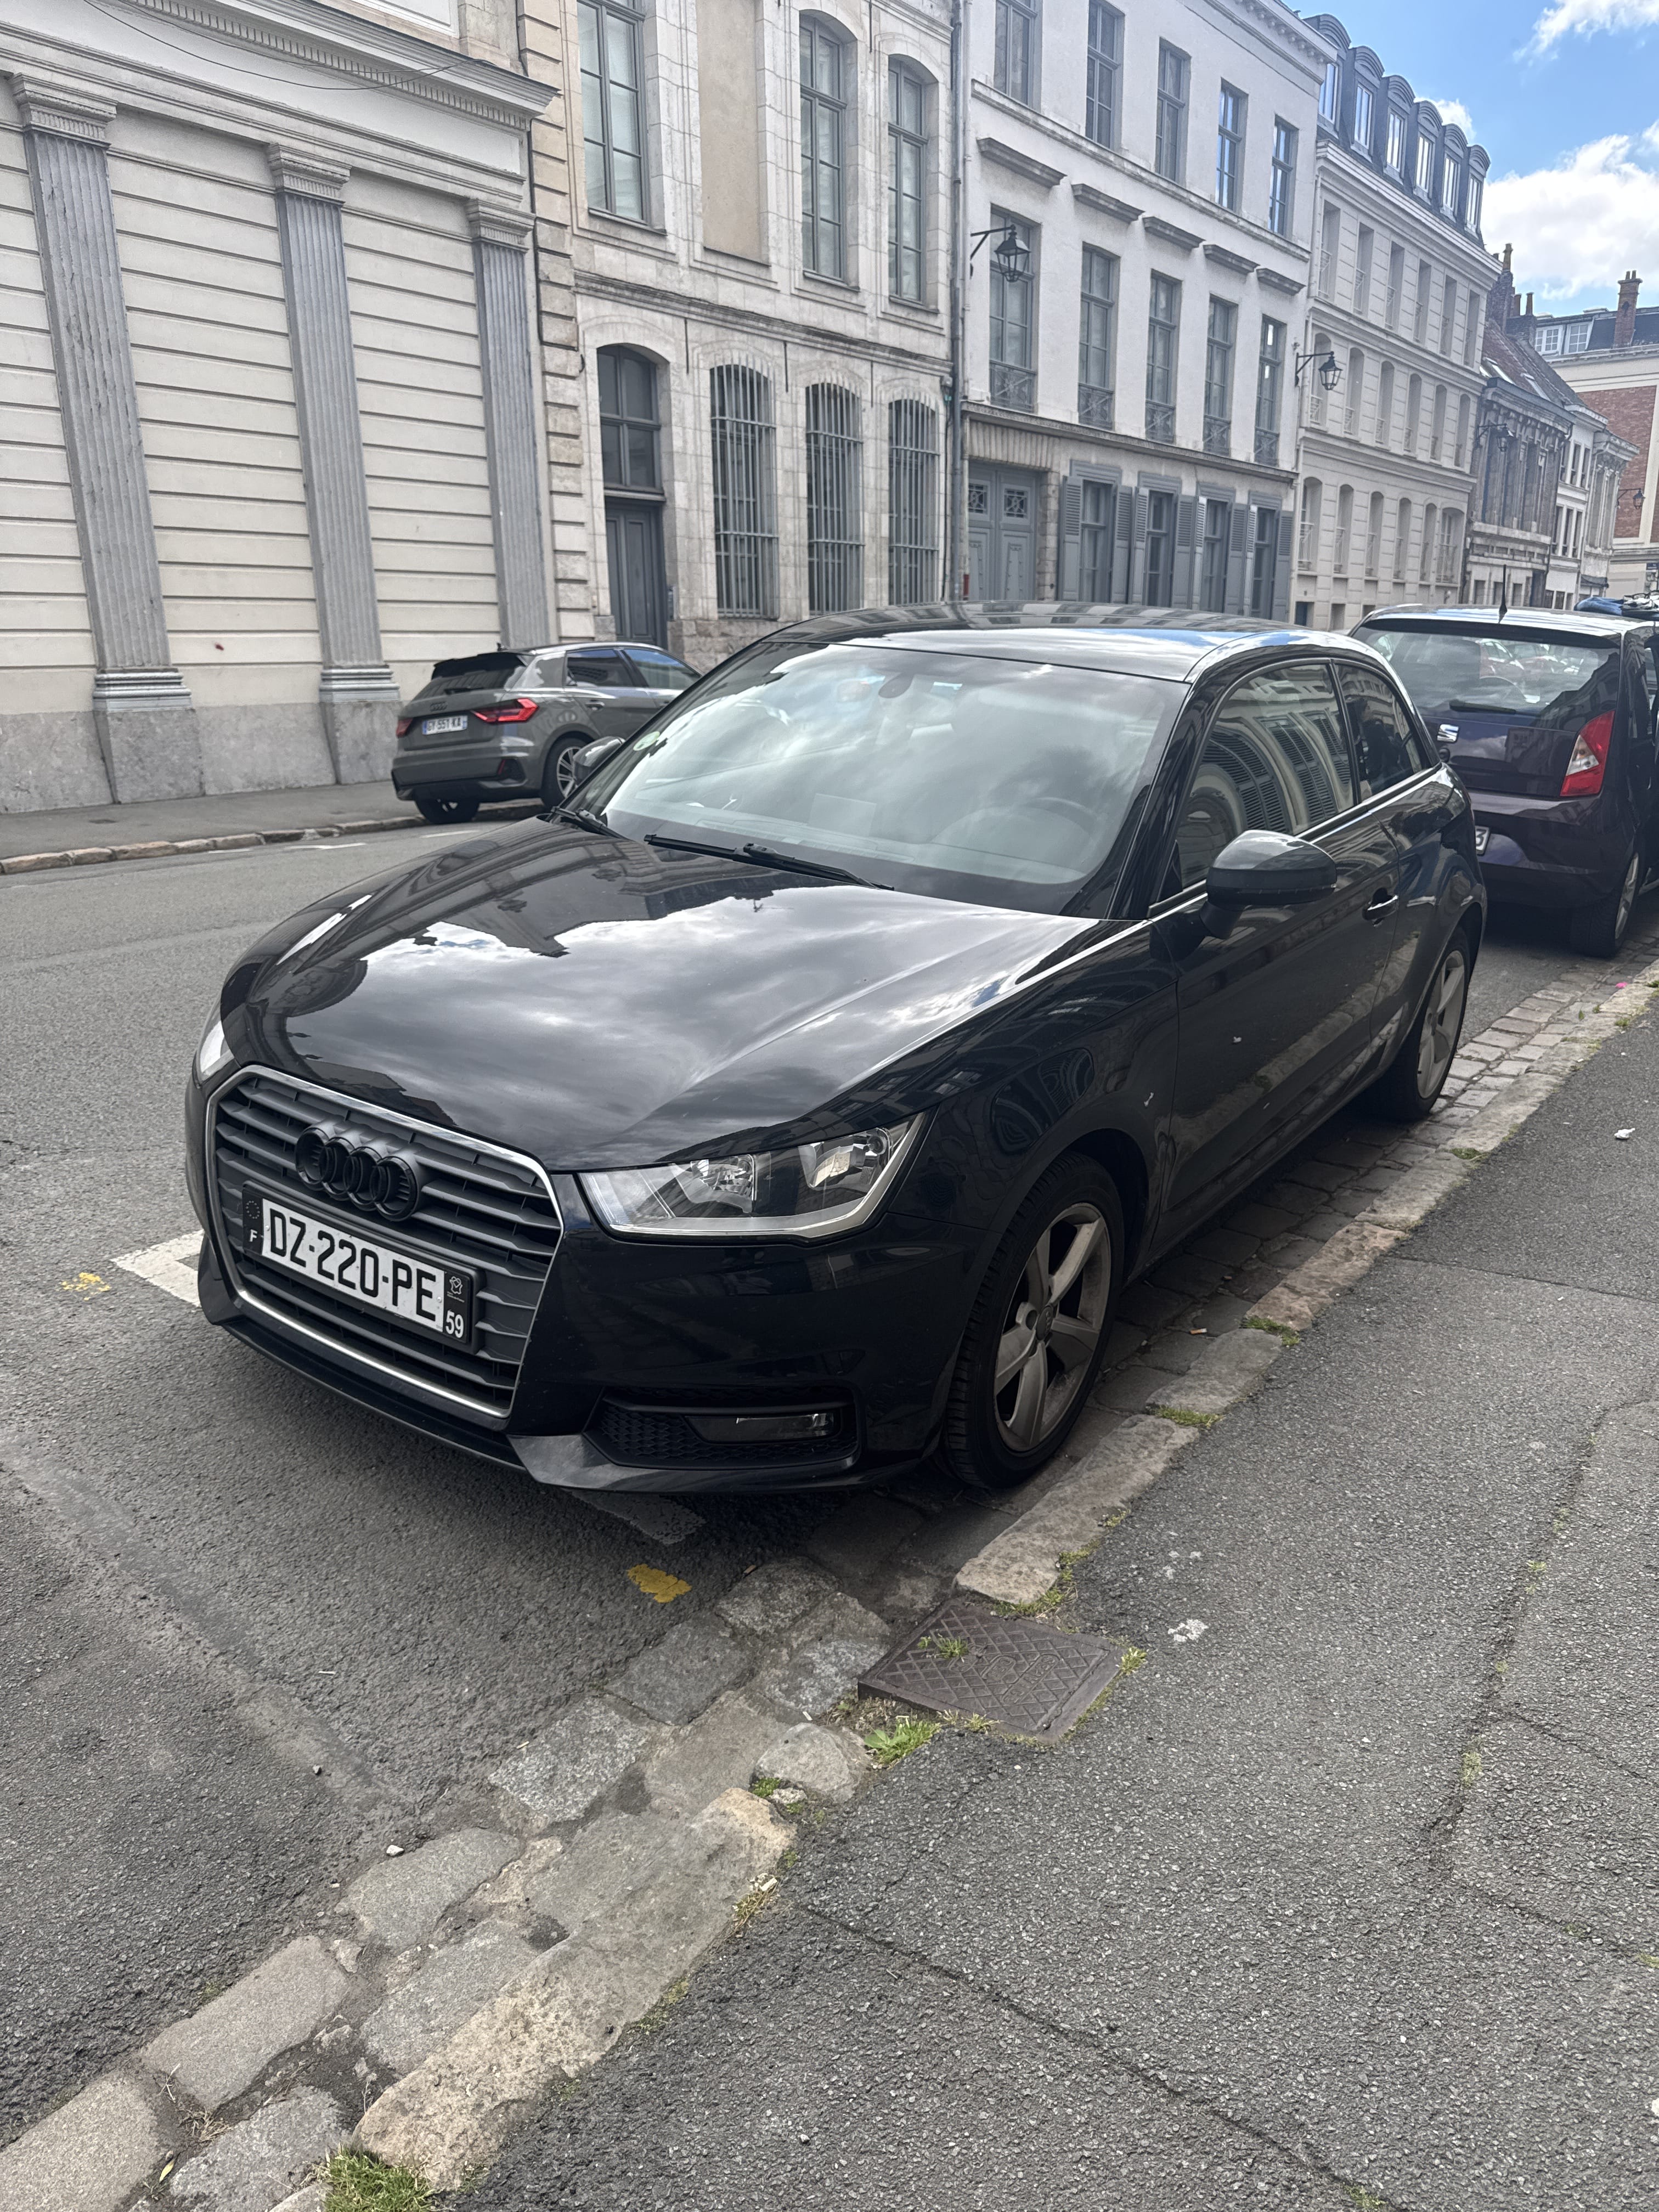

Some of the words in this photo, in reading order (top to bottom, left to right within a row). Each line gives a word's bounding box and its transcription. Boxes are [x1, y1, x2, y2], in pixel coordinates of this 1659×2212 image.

[249, 1229, 258, 1242] F
[270, 1208, 436, 1322] DZ-220-PE
[445, 1310, 464, 1338] 59
